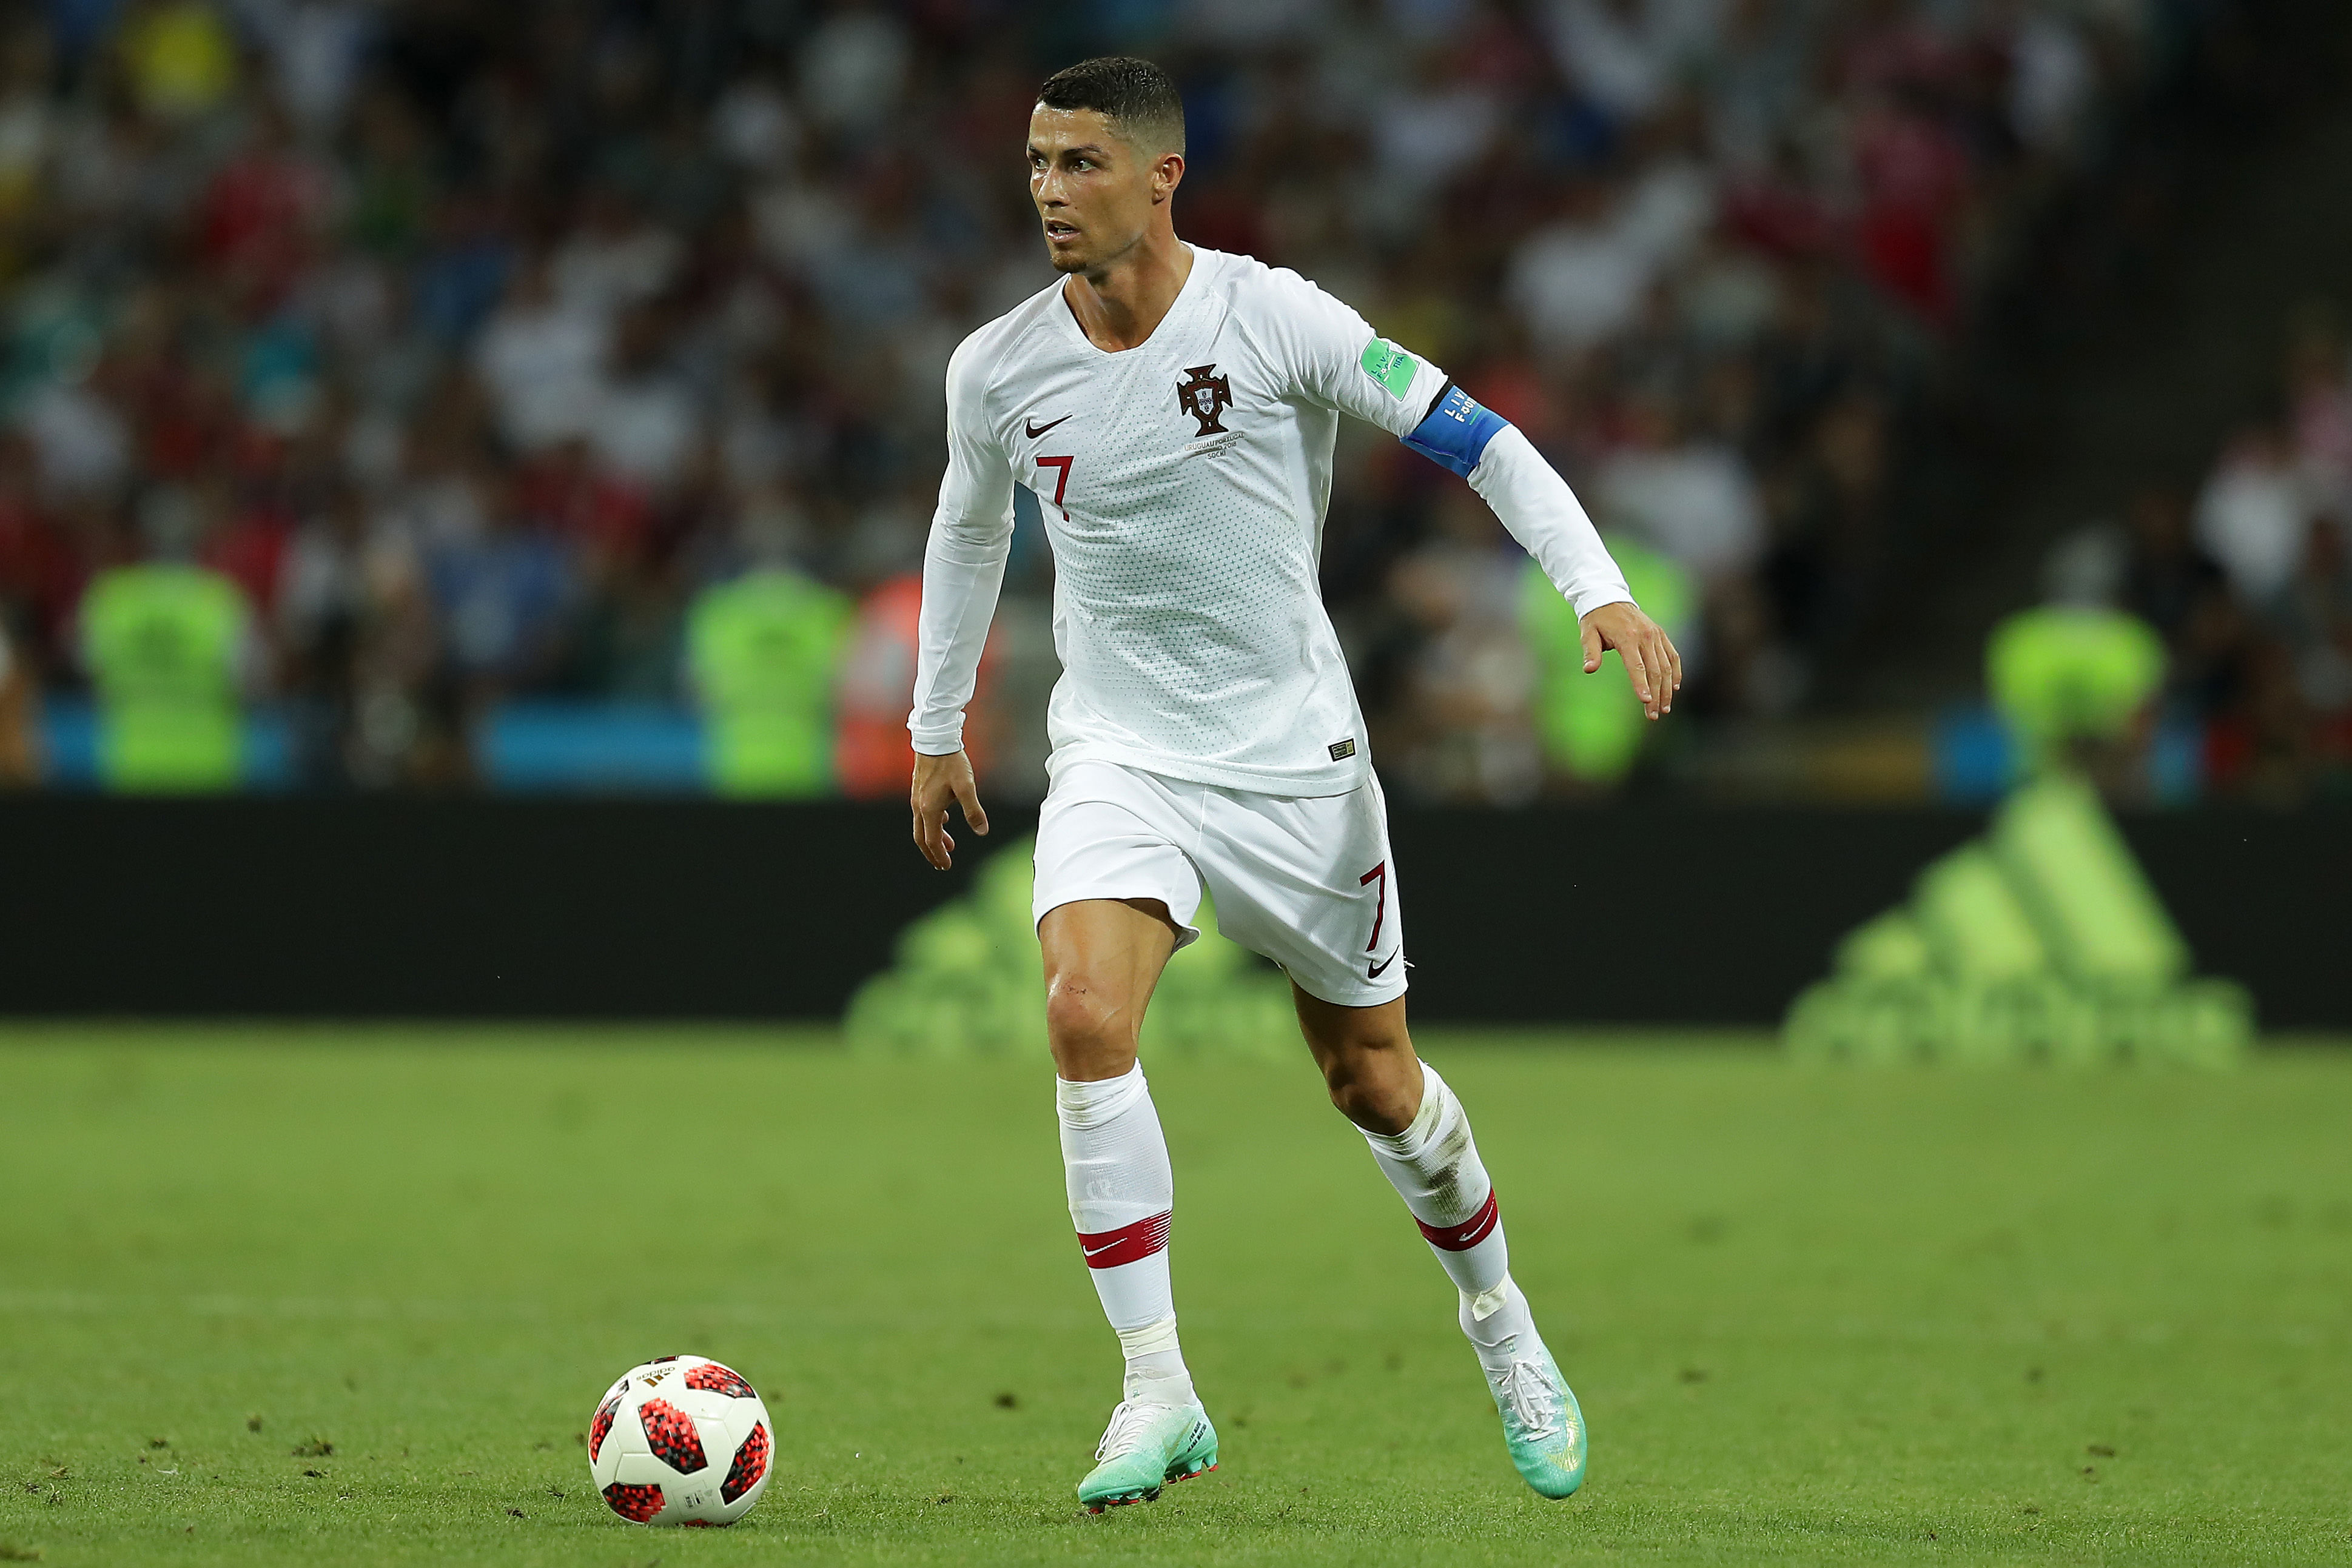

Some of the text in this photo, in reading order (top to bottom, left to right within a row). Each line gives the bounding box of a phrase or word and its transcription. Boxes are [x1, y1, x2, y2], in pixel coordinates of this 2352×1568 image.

[1393, 357, 1404, 369] FIFA
[1208, 451, 1226, 460] SOCHI
[1036, 456, 1074, 523] 7
[1359, 859, 1385, 952] 7
[636, 1367, 676, 1381] adidas
